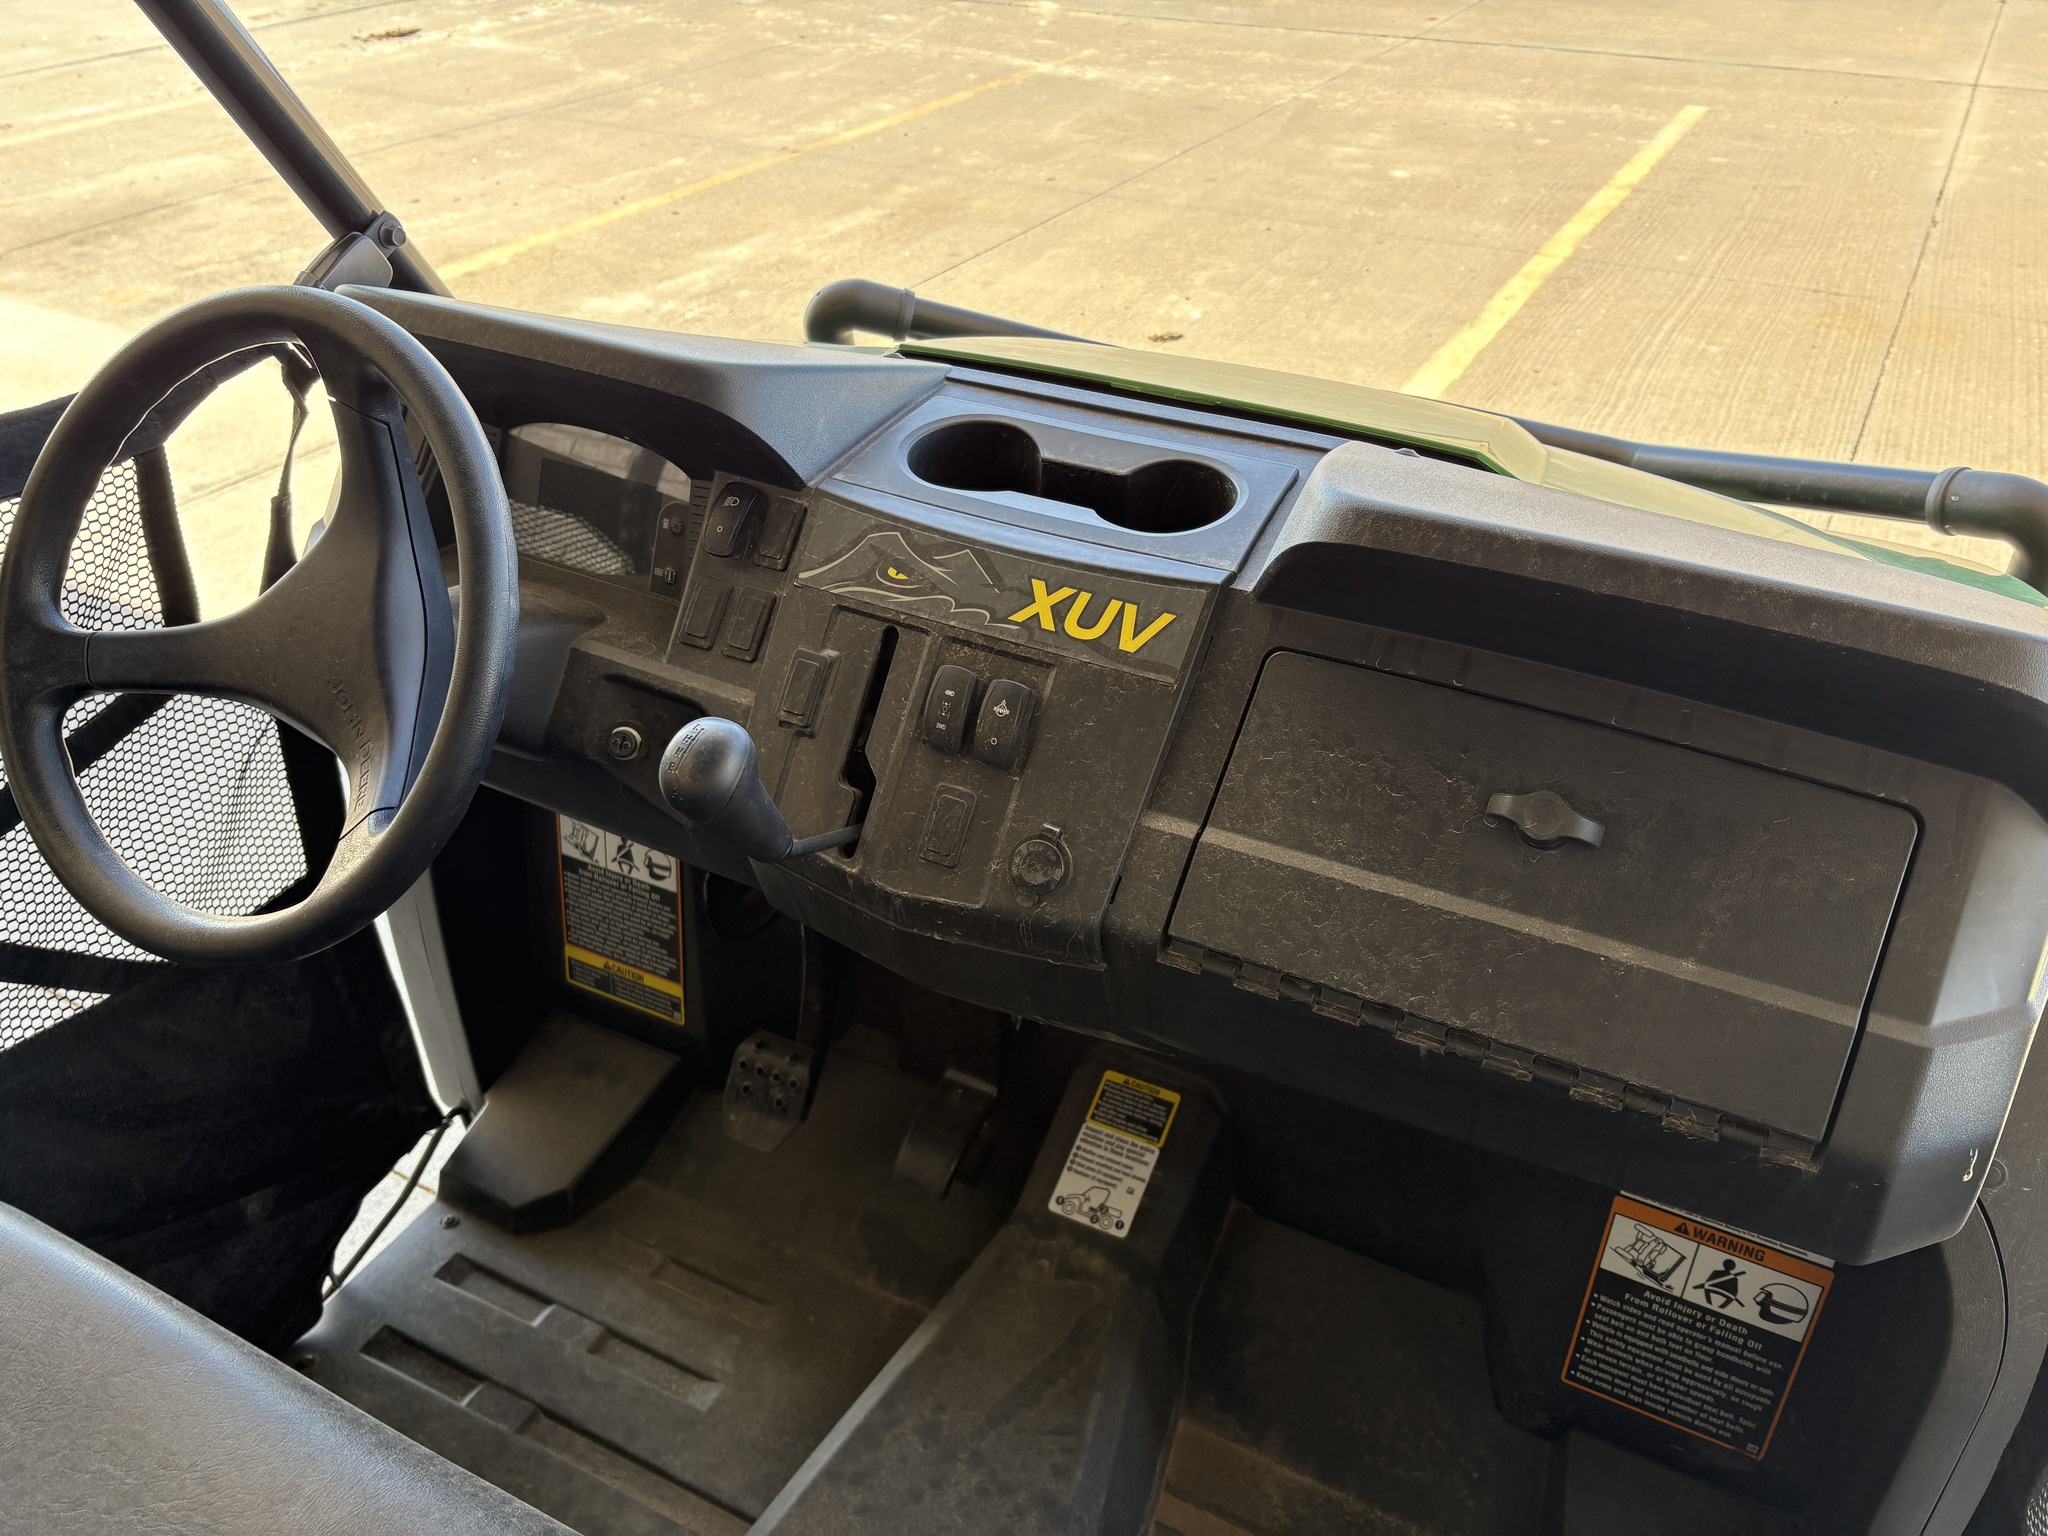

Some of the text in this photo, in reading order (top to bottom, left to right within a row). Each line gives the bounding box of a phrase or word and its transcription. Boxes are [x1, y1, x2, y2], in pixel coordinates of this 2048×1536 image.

[1009, 579, 1176, 653] XUV
[945, 689, 956, 697] 4WD
[327, 676, 374, 812] JOHN DEERE
[936, 722, 947, 730] 2WD
[611, 962, 644, 983] CAUTION
[1692, 1227, 1766, 1262] WARNING
[1593, 1312, 1609, 1323] seat
[1610, 1318, 1624, 1328] belt
[1625, 1325, 1635, 1333] on
[1636, 1328, 1650, 1338] and
[1650, 1334, 1667, 1345] both
[1668, 1340, 1683, 1351] feet
[1598, 1294, 1621, 1308] Watch
[1621, 1303, 1642, 1316] video
[1642, 1311, 1657, 1321] and
[1658, 1317, 1674, 1328] read
[1675, 1323, 1713, 1344] operator's
[1714, 1338, 1741, 1353] manual
[1742, 1349, 1767, 1363] before
[1623, 1292, 1762, 1350] From Rollover or Falling Off
[1643, 1289, 1748, 1335] Avoid Injury or Death
[1595, 1303, 1636, 1325] Passengers
[1637, 1319, 1655, 1331] must
[1656, 1326, 1666, 1335] be
[1667, 1330, 1683, 1341] able
[1684, 1337, 1693, 1345] to
[1693, 1342, 1714, 1355] grasp
[1754, 1364, 1772, 1375] with
[1575, 1371, 1593, 1384] Keep
[1580, 1354, 1597, 1365] Each
[1648, 1381, 1666, 1392] have
[1585, 1337, 1604, 1349] Wear
[1604, 1345, 1633, 1361] helmets
[1633, 1356, 1653, 1369] when
[1653, 1364, 1680, 1380] driving
[1729, 1395, 1740, 1403] on
[1740, 1398, 1763, 1413] rough
[1588, 1329, 1604, 1339] This
[1603, 1335, 1626, 1350] safety
[1625, 1343, 1664, 1364] equipment
[1664, 1358, 1683, 1370] must
[1683, 1365, 1694, 1375] be
[1711, 1377, 1722, 1387] by
[1722, 1381, 1734, 1390] all
[1653, 1345, 1669, 1355] with
[1700, 1363, 1713, 1373] and
[1698, 1411, 1708, 1419] of
